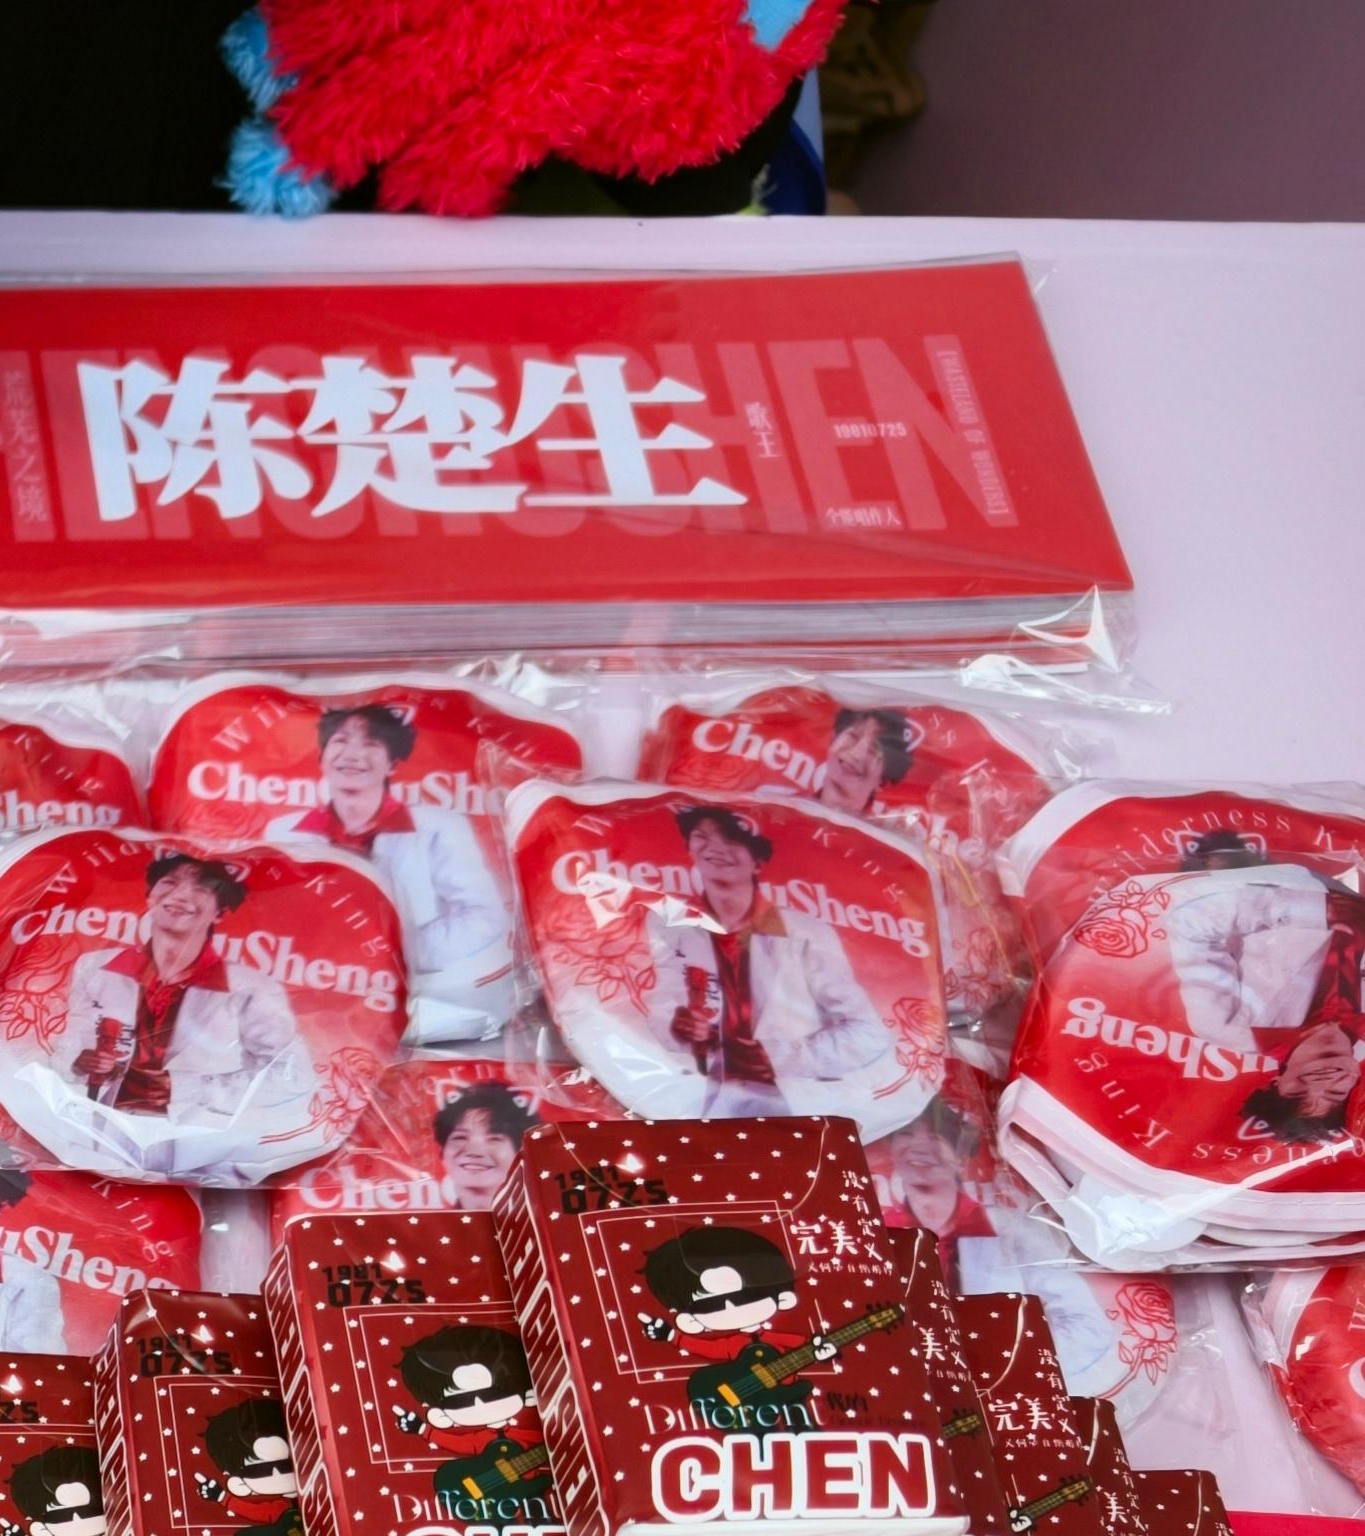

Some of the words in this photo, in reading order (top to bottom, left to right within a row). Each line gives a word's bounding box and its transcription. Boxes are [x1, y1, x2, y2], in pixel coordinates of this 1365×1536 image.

[78, 355, 747, 518] 陈楚生
[793, 1221, 859, 1256] 完美
[327, 1279, 426, 1309] 0725
[644, 1398, 828, 1435] Different
[988, 1397, 1053, 1432] 完美
[652, 1431, 936, 1523] CHEN
